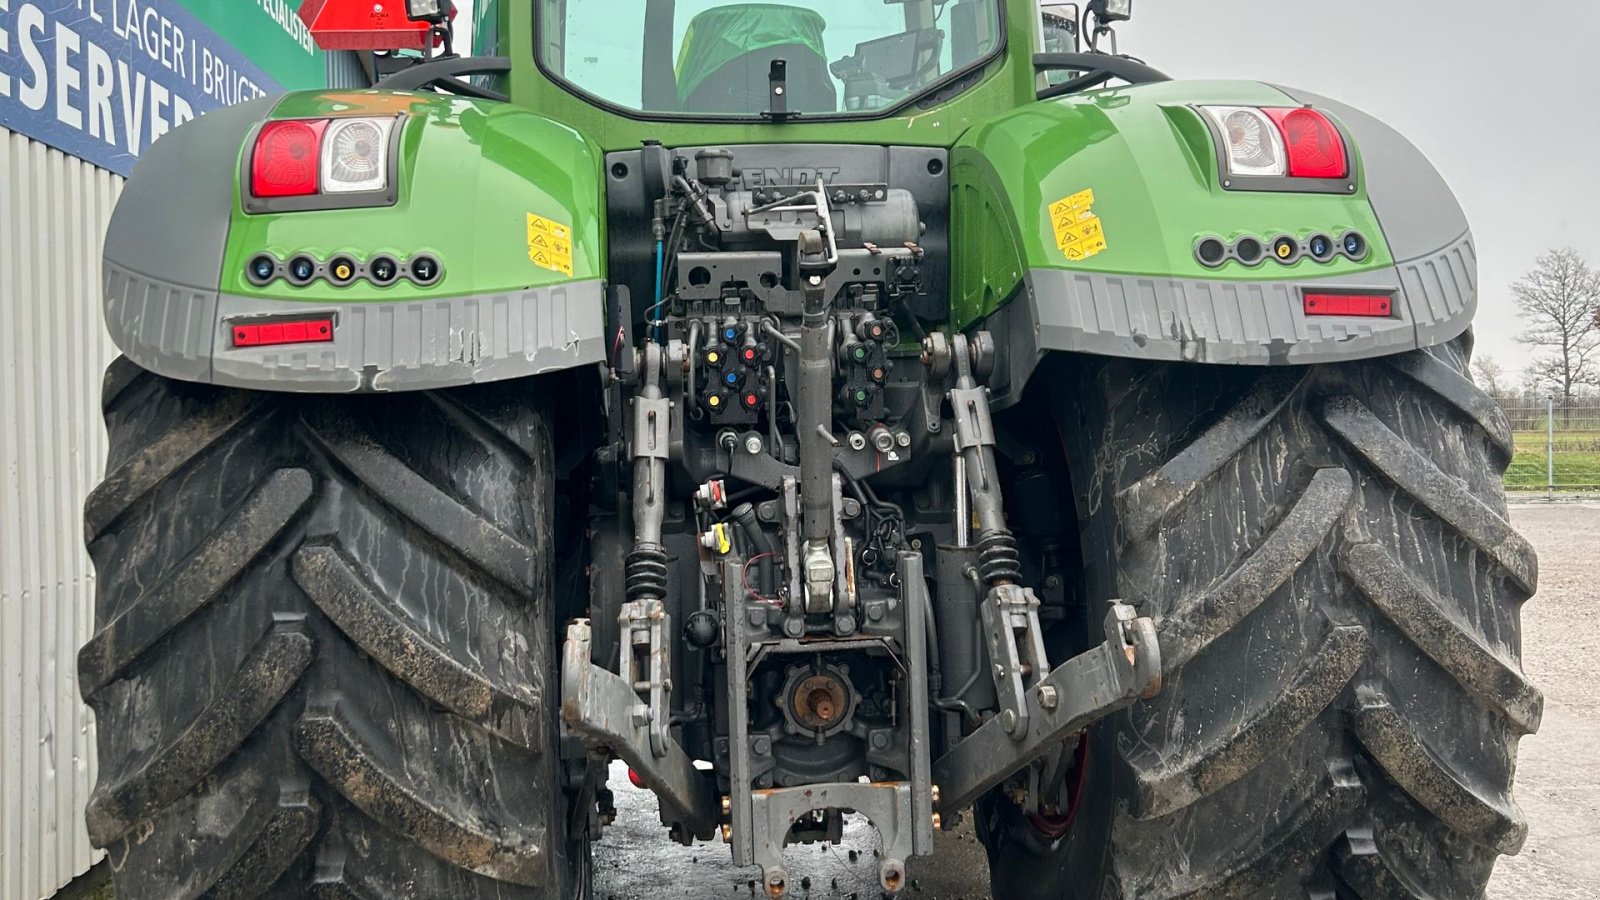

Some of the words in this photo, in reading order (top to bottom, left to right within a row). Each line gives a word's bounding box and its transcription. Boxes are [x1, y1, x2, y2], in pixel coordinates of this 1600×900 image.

[113, 0, 185, 78] LAGER
[192, 39, 197, 85] I
[203, 47, 266, 106] BRUGT
